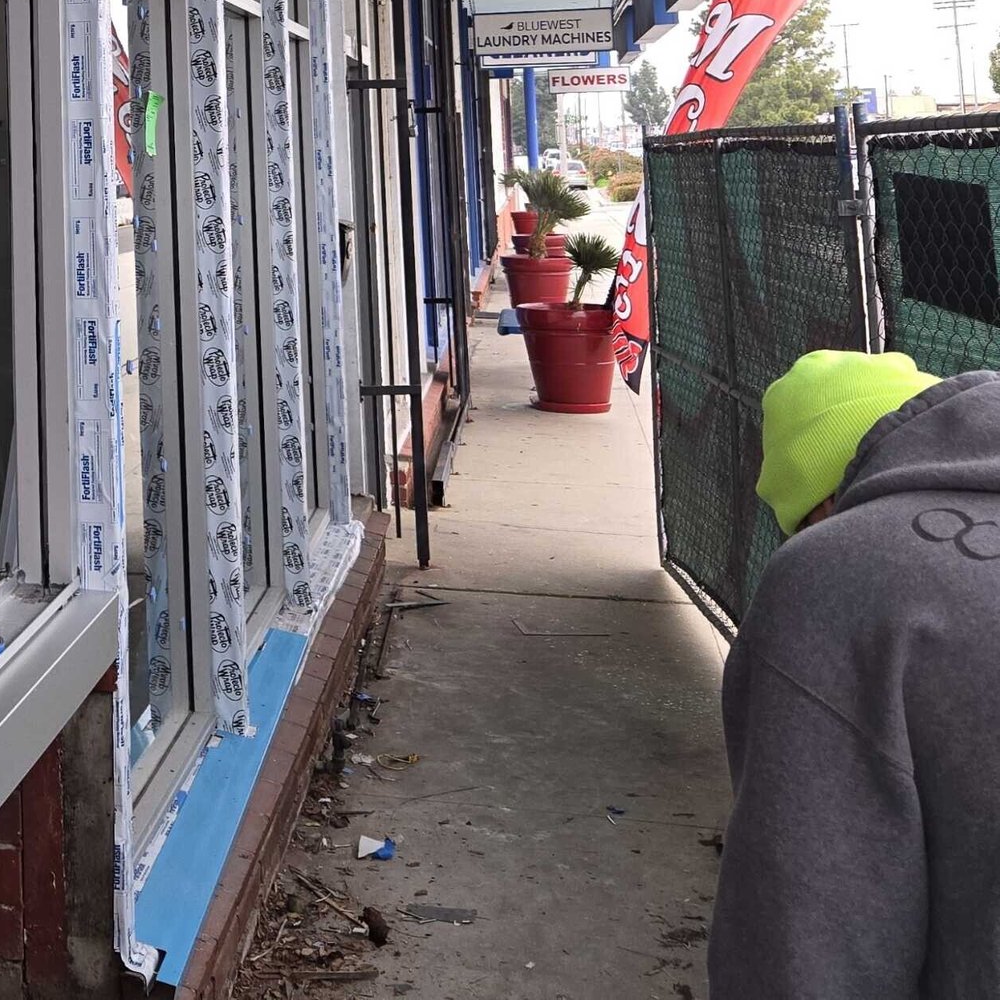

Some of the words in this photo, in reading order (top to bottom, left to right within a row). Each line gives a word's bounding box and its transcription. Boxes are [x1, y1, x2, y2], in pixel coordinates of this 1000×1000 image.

[477, 33, 537, 48] LAUNDRY
[541, 31, 611, 46] MACHINES
[517, 19, 581, 32] BLUEWEST
[72, 56, 80, 99] FortiFlash
[191, 59, 205, 80] Wrap
[196, 50, 217, 82] Protecto
[551, 73, 628, 88] FLOWERS
[83, 121, 92, 165] FortiFlash
[198, 173, 216, 204] Protecto
[203, 225, 217, 247] Wrap
[77, 252, 85, 297] FortiFlash
[87, 320, 97, 365] FortiFlash
[203, 357, 218, 380] Wrap
[208, 349, 230, 381] Protecto
[81, 454, 90, 500] FortiFlash
[206, 485, 217, 508] Wrap
[208, 477, 230, 511] Protecto
[93, 525, 103, 571] FortiFlash
[217, 532, 231, 555] Wrap
[211, 614, 232, 648] Protecto
[218, 670, 232, 693] Wrap
[222, 662, 242, 696] Protecto
